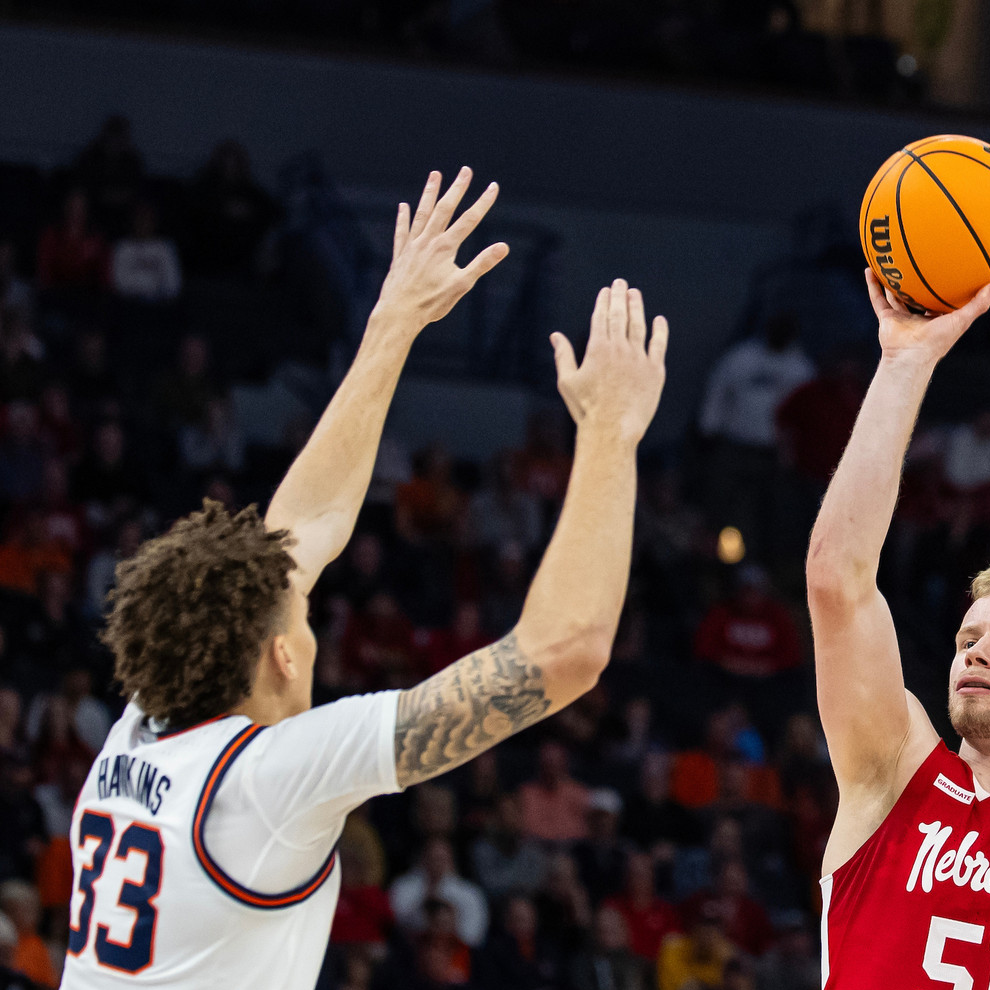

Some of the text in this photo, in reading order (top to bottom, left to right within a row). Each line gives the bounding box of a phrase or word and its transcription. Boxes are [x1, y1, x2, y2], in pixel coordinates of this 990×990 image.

[869, 214, 922, 309] Wilso
[937, 778, 971, 801] GRADUATE
[67, 808, 165, 976] 33
